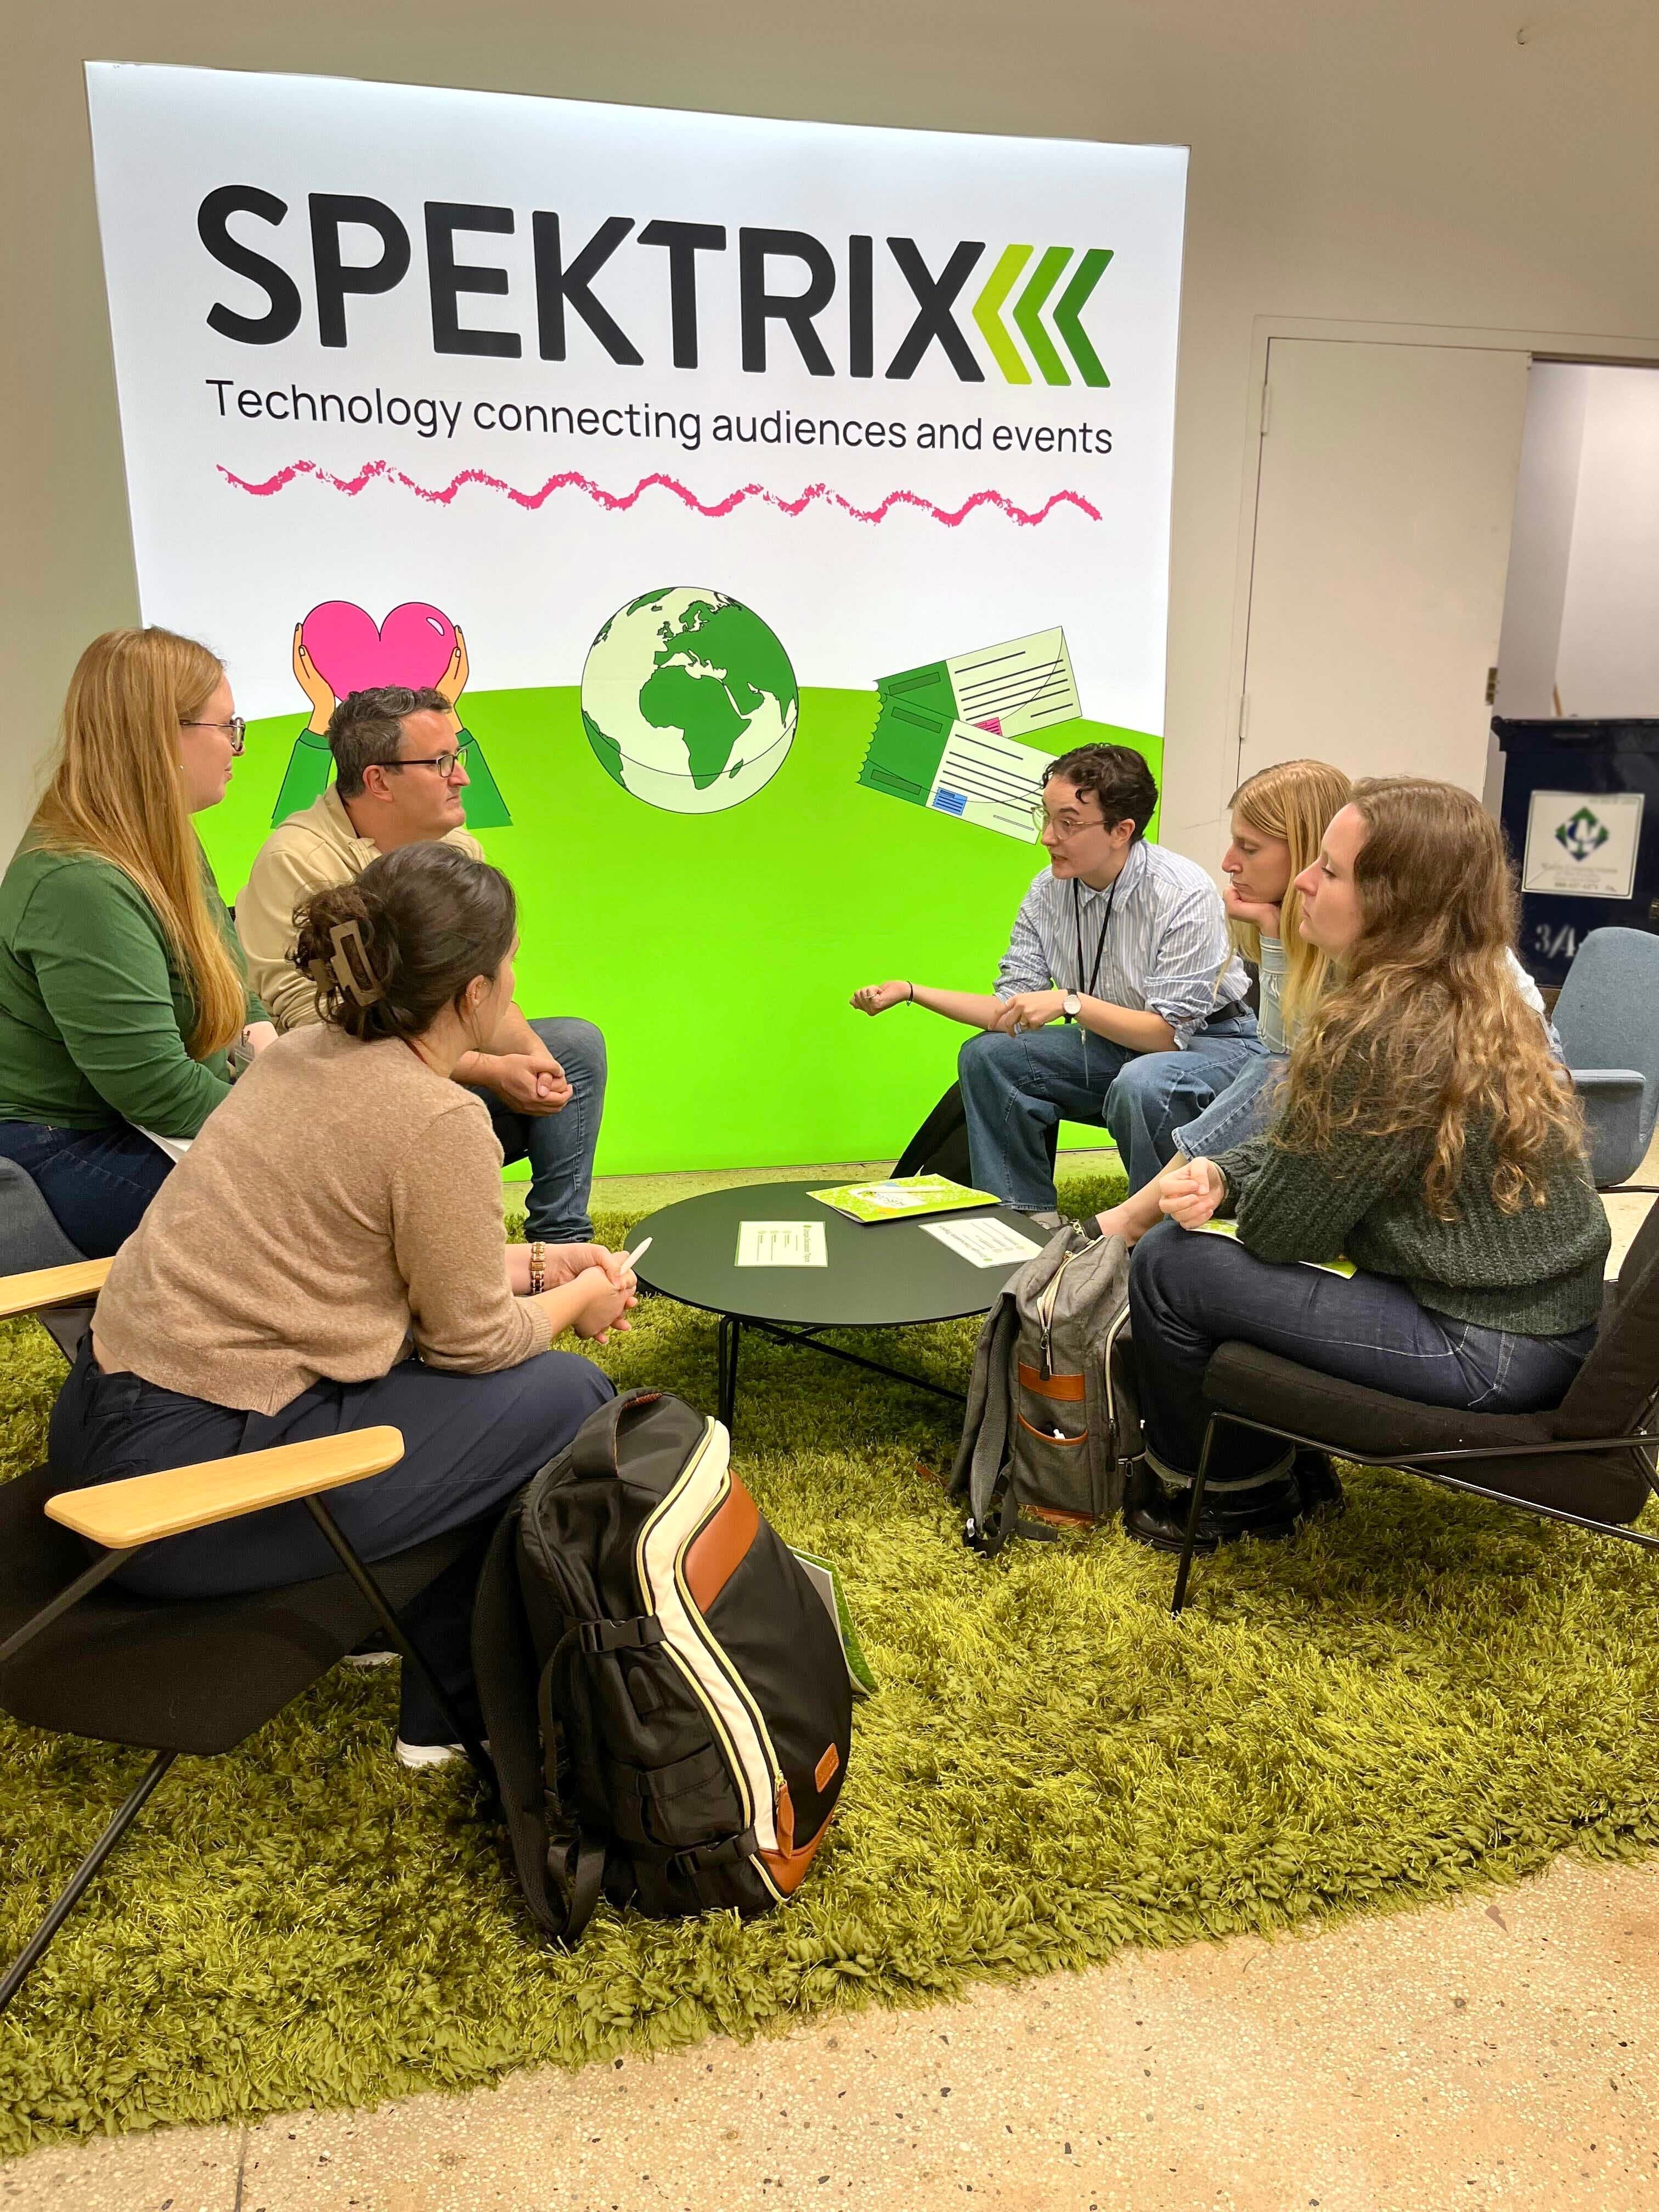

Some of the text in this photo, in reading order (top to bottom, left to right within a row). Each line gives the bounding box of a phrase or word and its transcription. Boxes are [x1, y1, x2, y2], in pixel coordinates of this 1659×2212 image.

[197, 184, 986, 383] SPEKTRIX
[205, 379, 1113, 454] Technology connecting audiences and events
